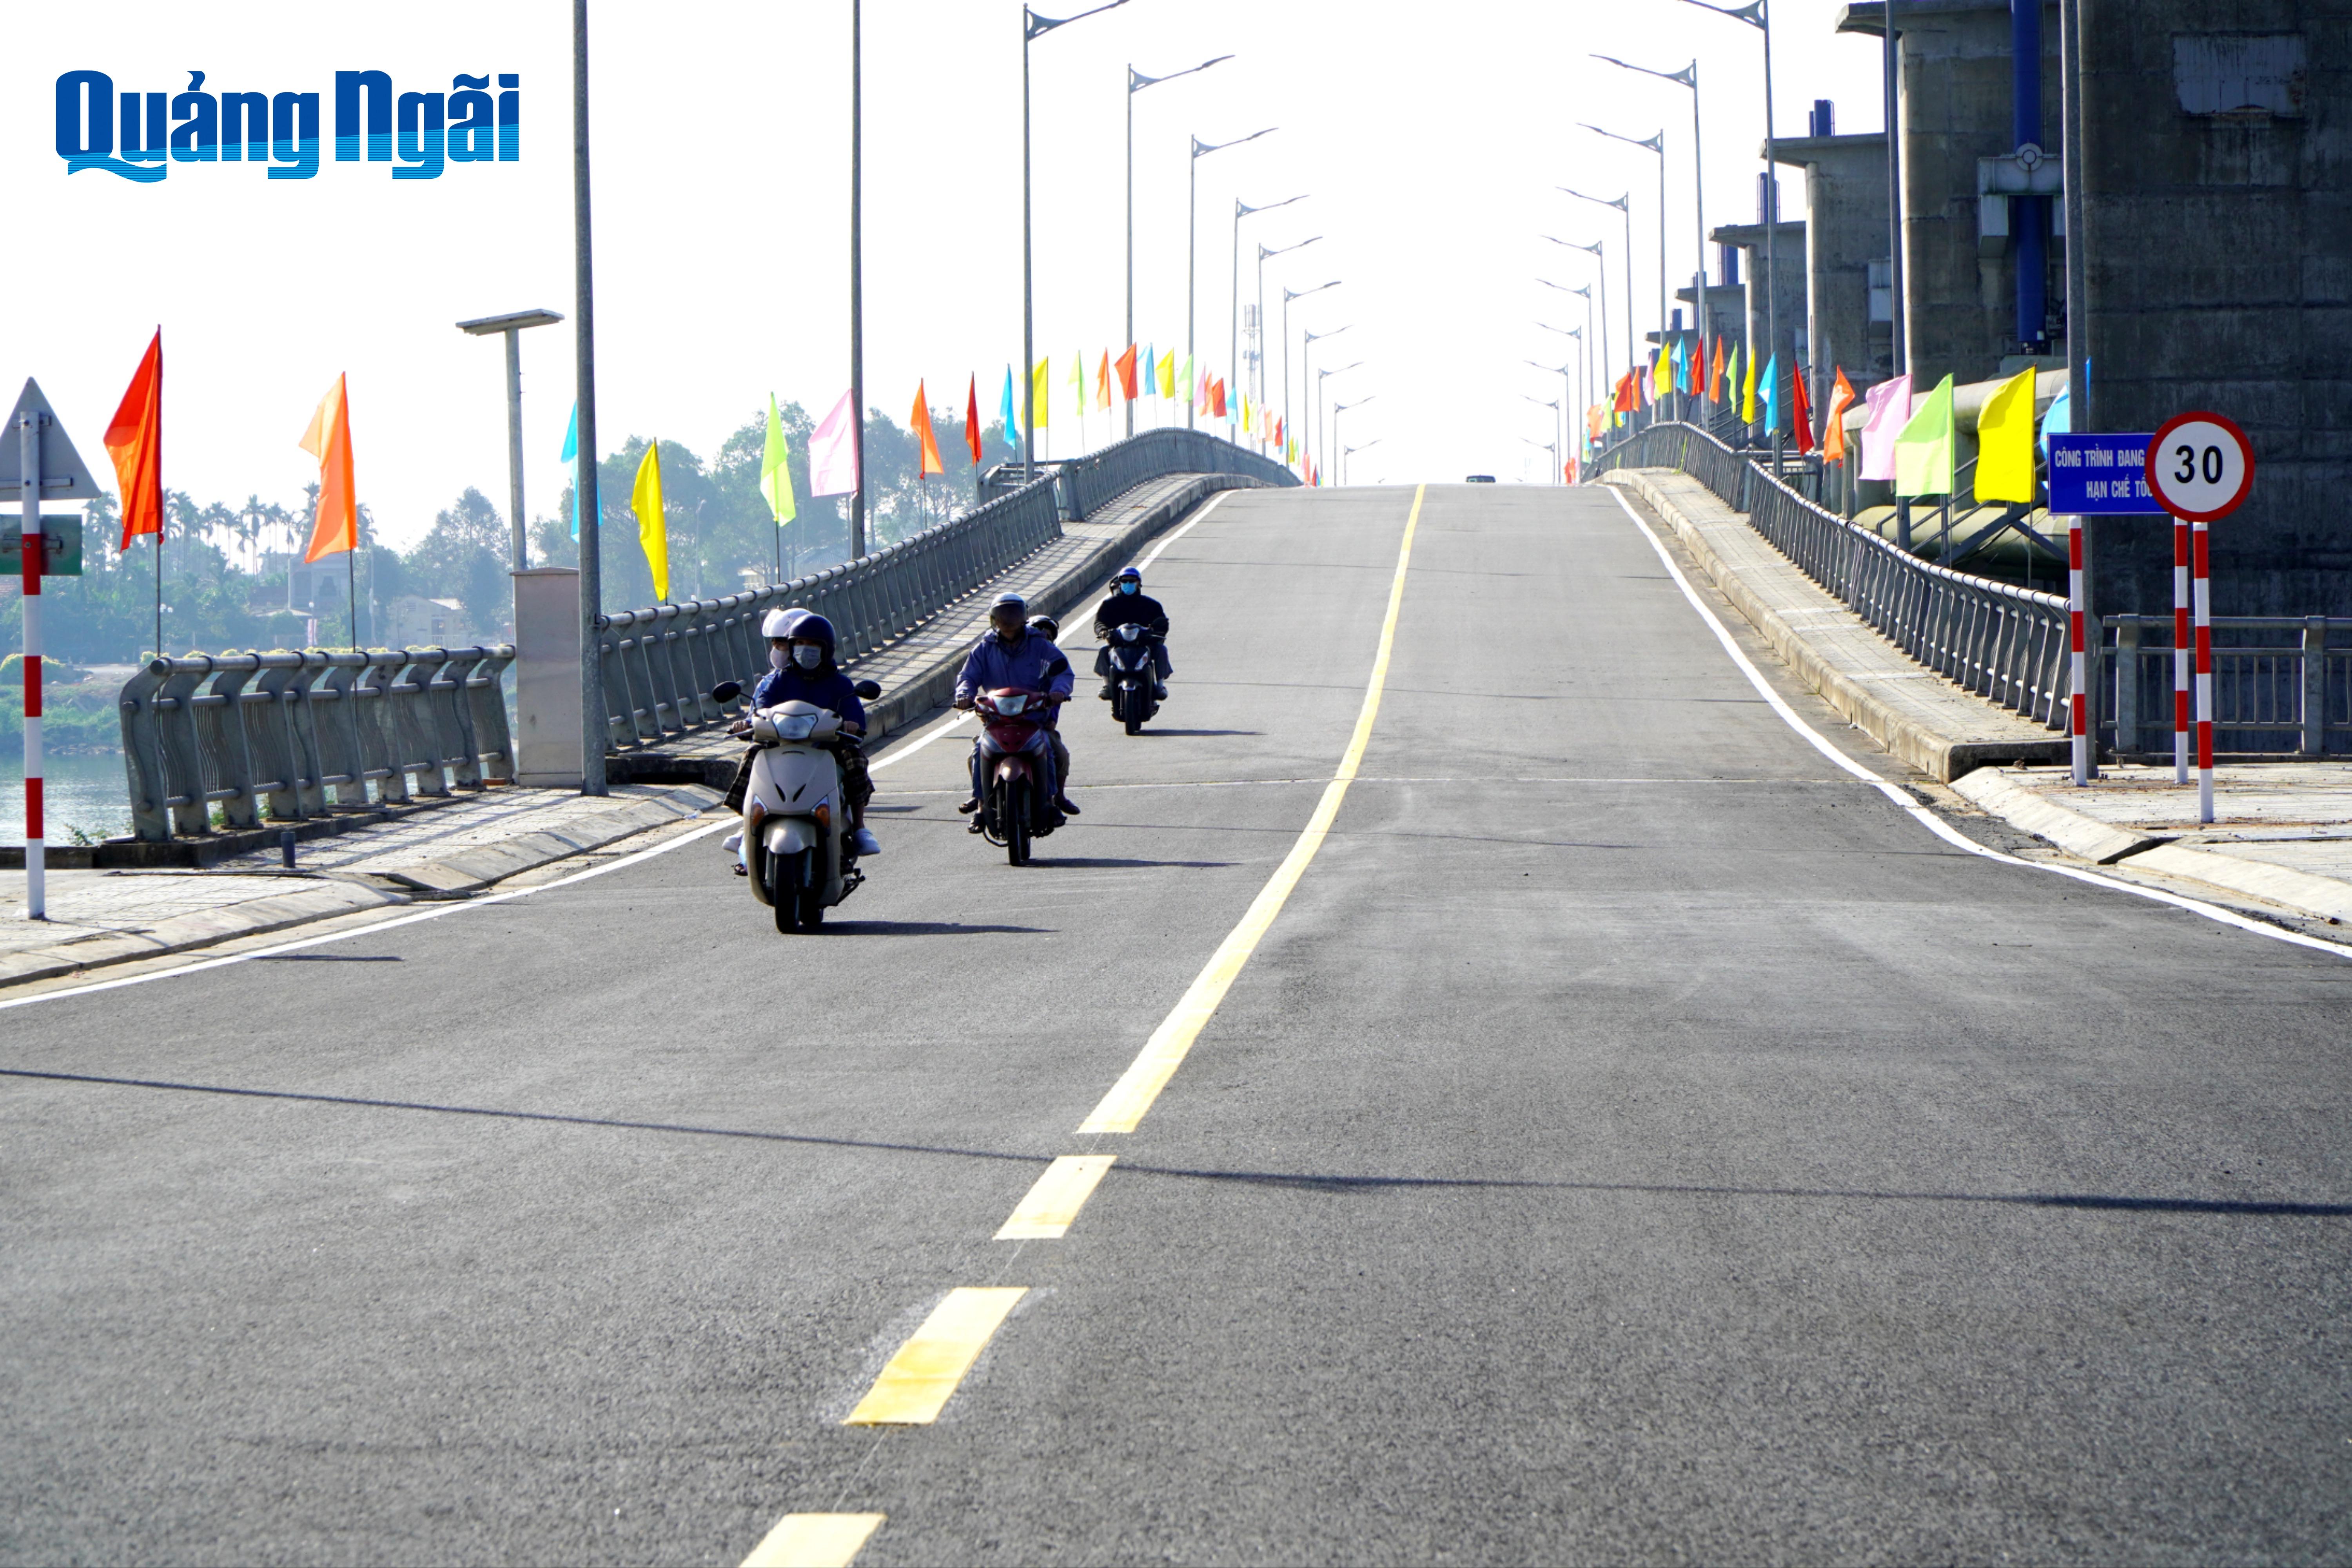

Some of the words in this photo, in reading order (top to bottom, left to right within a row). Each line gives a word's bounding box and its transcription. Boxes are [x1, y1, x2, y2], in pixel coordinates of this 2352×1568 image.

[2055, 446, 2082, 467] CÔNG
[2084, 443, 2113, 467] TRÌNH
[2118, 449, 2145, 466] ĐANG
[2174, 445, 2223, 484] 30
[2086, 481, 2107, 501] HẠN
[2111, 474, 2130, 497] CHẾ
